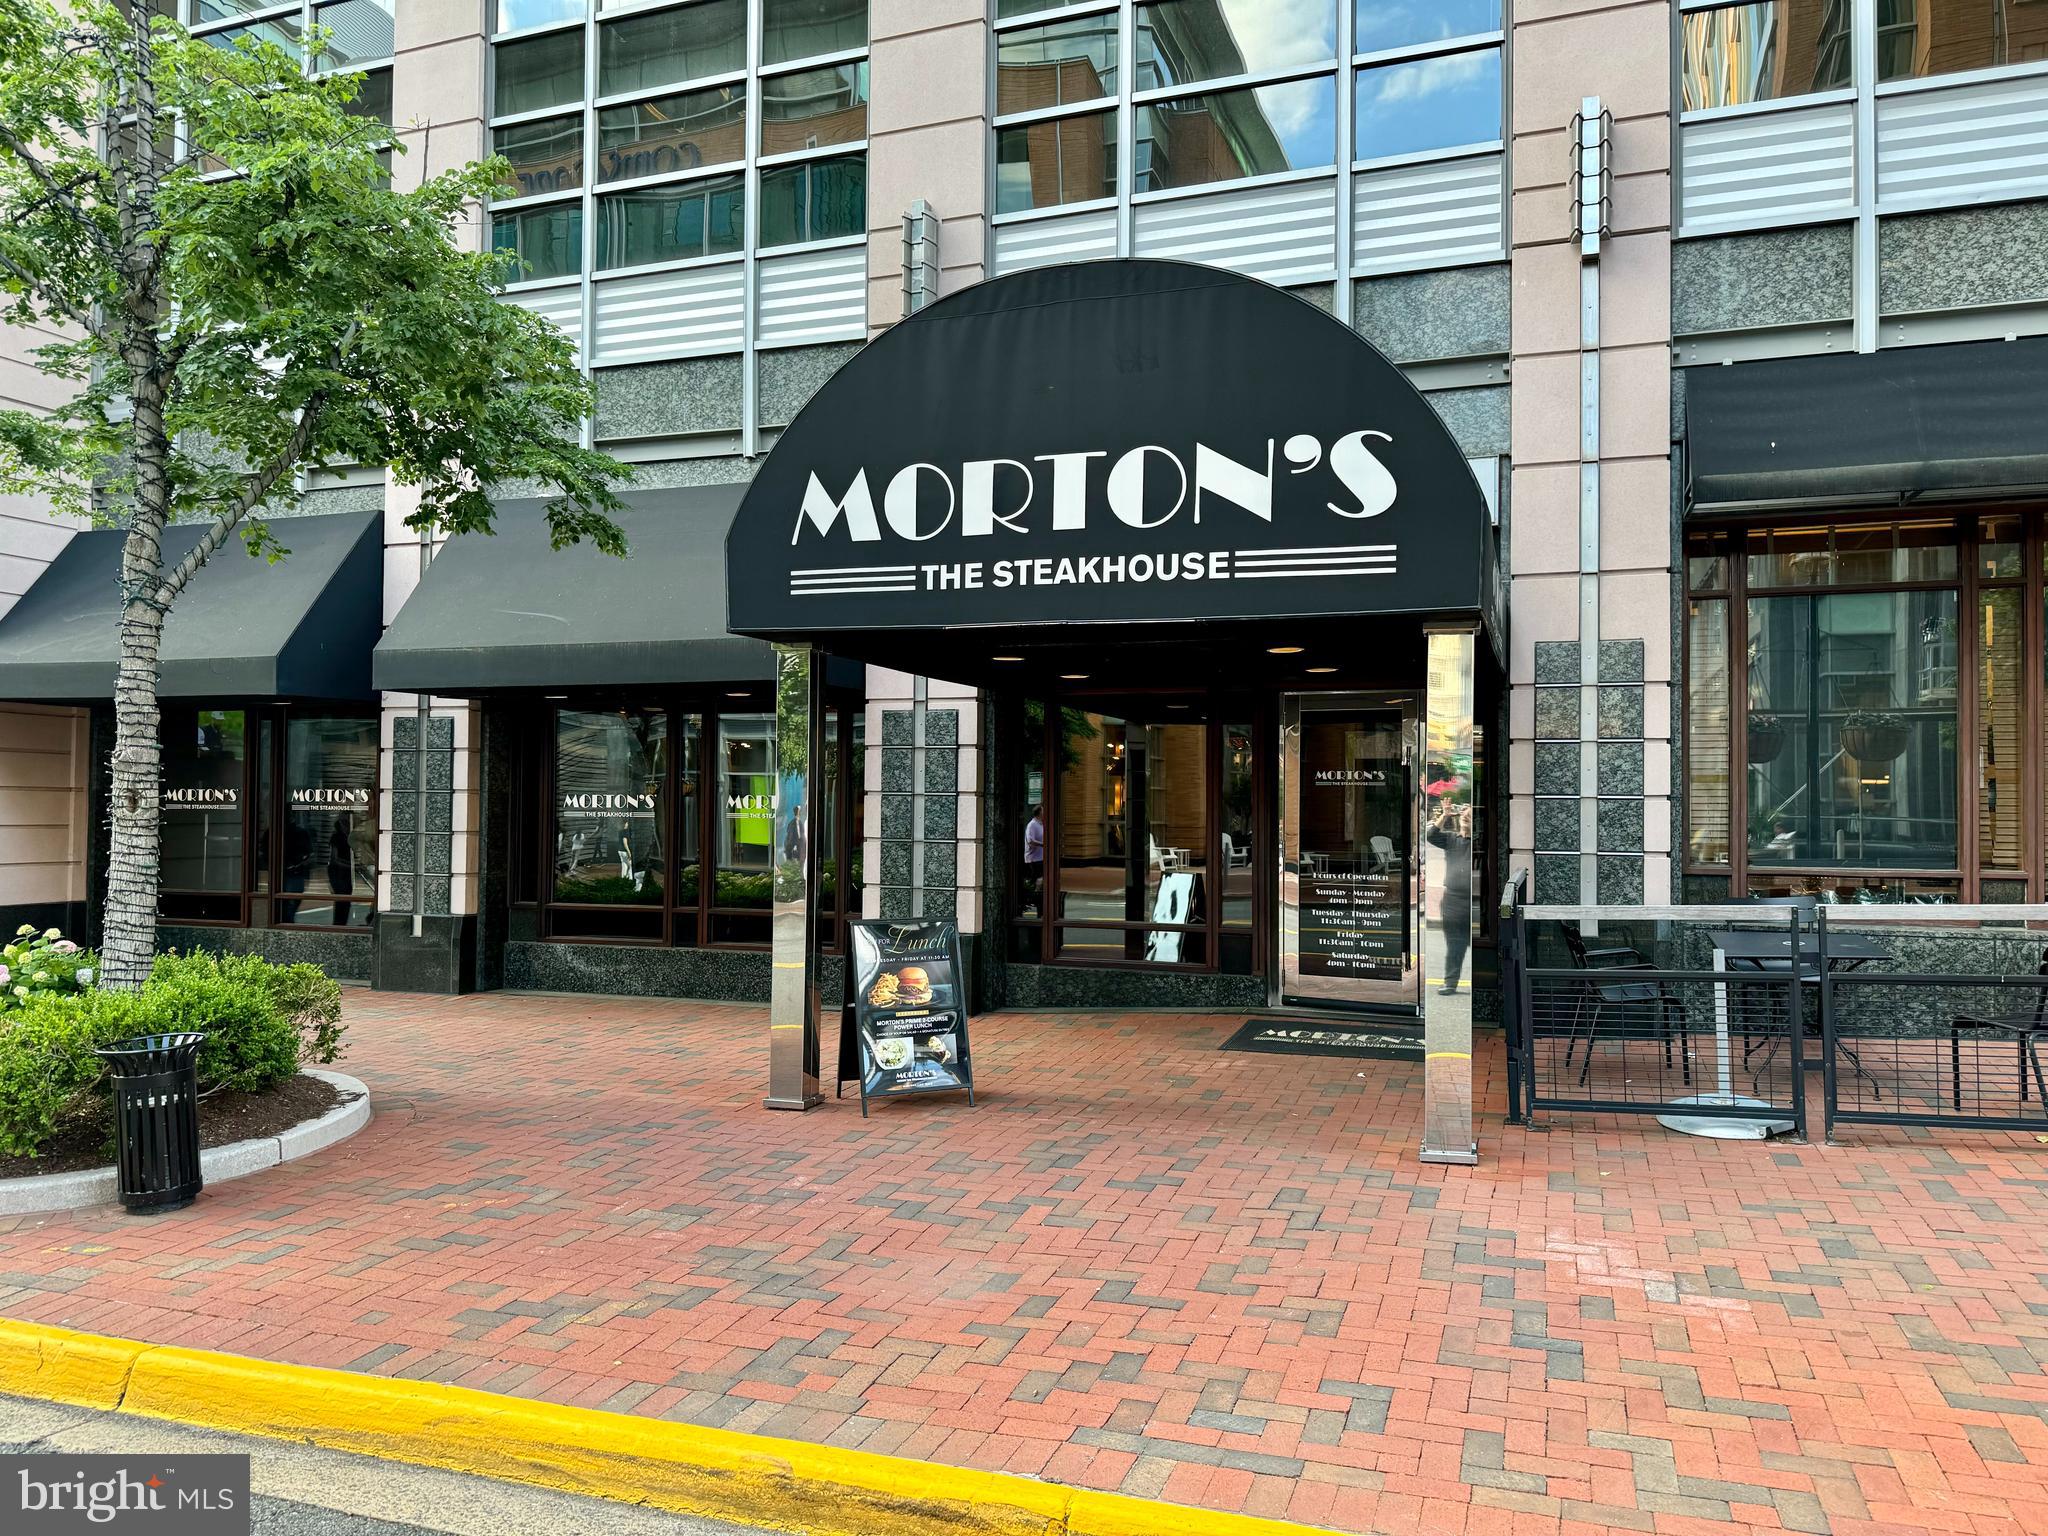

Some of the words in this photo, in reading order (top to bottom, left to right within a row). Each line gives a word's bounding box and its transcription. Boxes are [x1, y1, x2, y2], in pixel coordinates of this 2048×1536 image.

[791, 430, 1397, 546] MORTON'S
[921, 563, 983, 592] THE
[992, 550, 1230, 588] STEAKHOUSE
[1314, 770, 1386, 780] MORTON'S
[165, 788, 237, 801] MORTON'S
[291, 788, 369, 803] MORTON'S
[563, 793, 655, 809] MORTON'S
[1347, 873, 1389, 881] Operation
[1315, 888, 1347, 896] Sunday
[1312, 909, 1346, 917] Tuesday
[1351, 911, 1390, 919] Thursday
[884, 925, 954, 954] Lunch
[1337, 931, 1364, 939] Friday
[1319, 938, 1354, 946] 11:30am
[1331, 951, 1370, 960] Saturday
